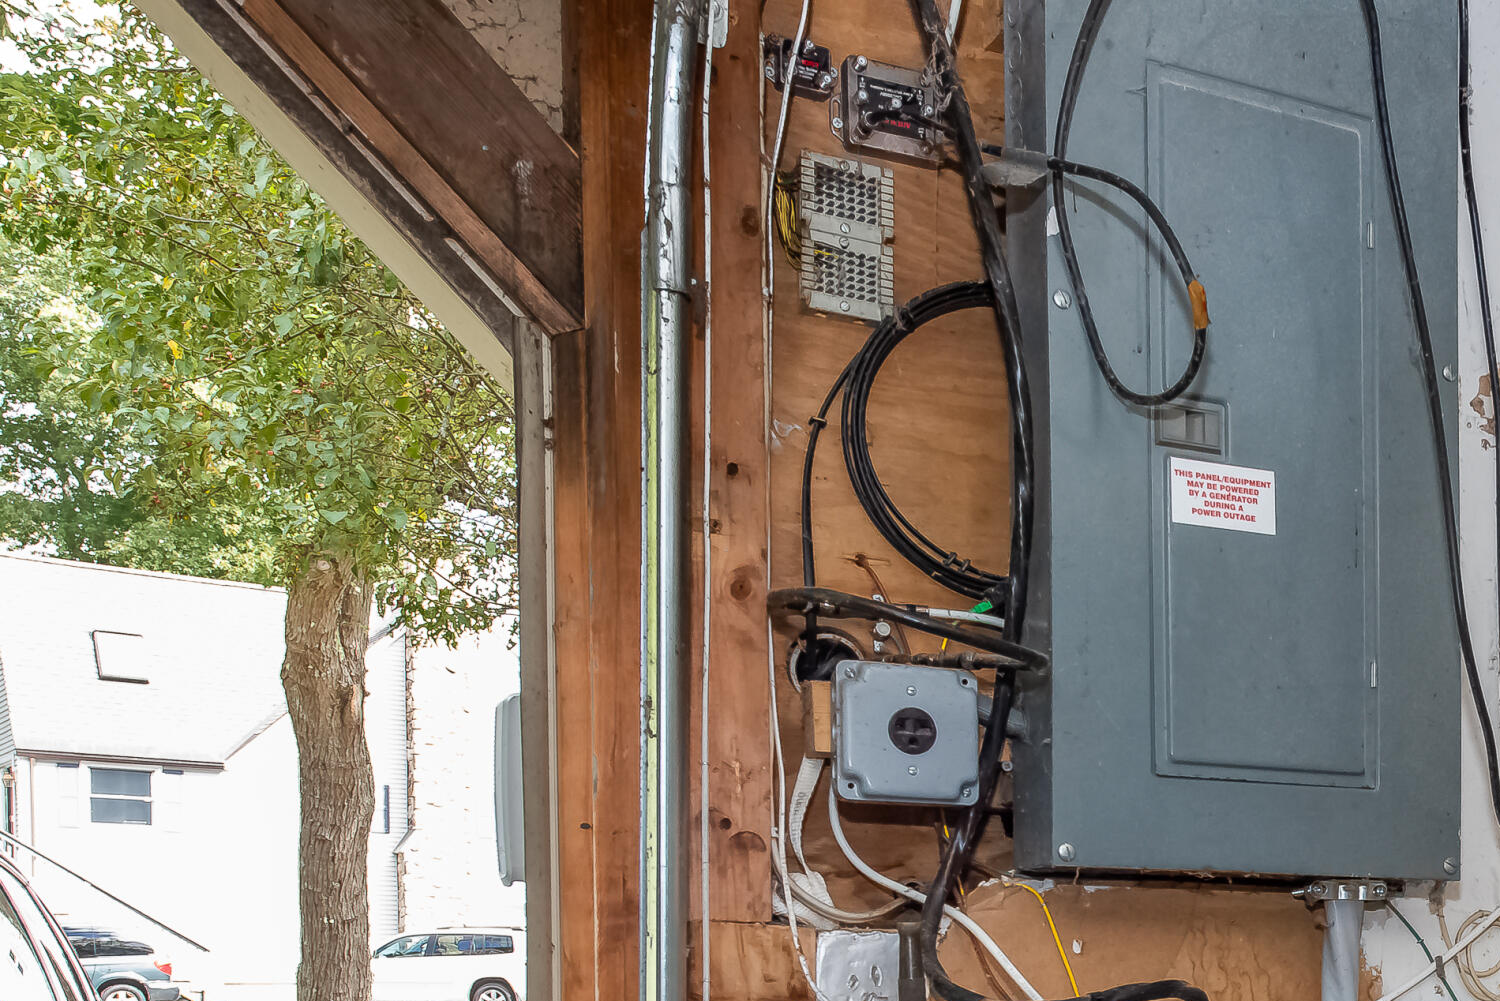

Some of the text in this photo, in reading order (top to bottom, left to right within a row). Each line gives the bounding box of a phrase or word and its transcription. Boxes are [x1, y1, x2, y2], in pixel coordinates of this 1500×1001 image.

[1174, 469, 1271, 488] THIS PANEL/EQUIPMENT
[1187, 480, 1259, 496] MAY BE POWERED
[1189, 489, 1199, 497] BY
[1210, 493, 1258, 504] GENERATOR
[1204, 501, 1236, 510] DURING
[1192, 508, 1256, 522] POWER OUTAGE
